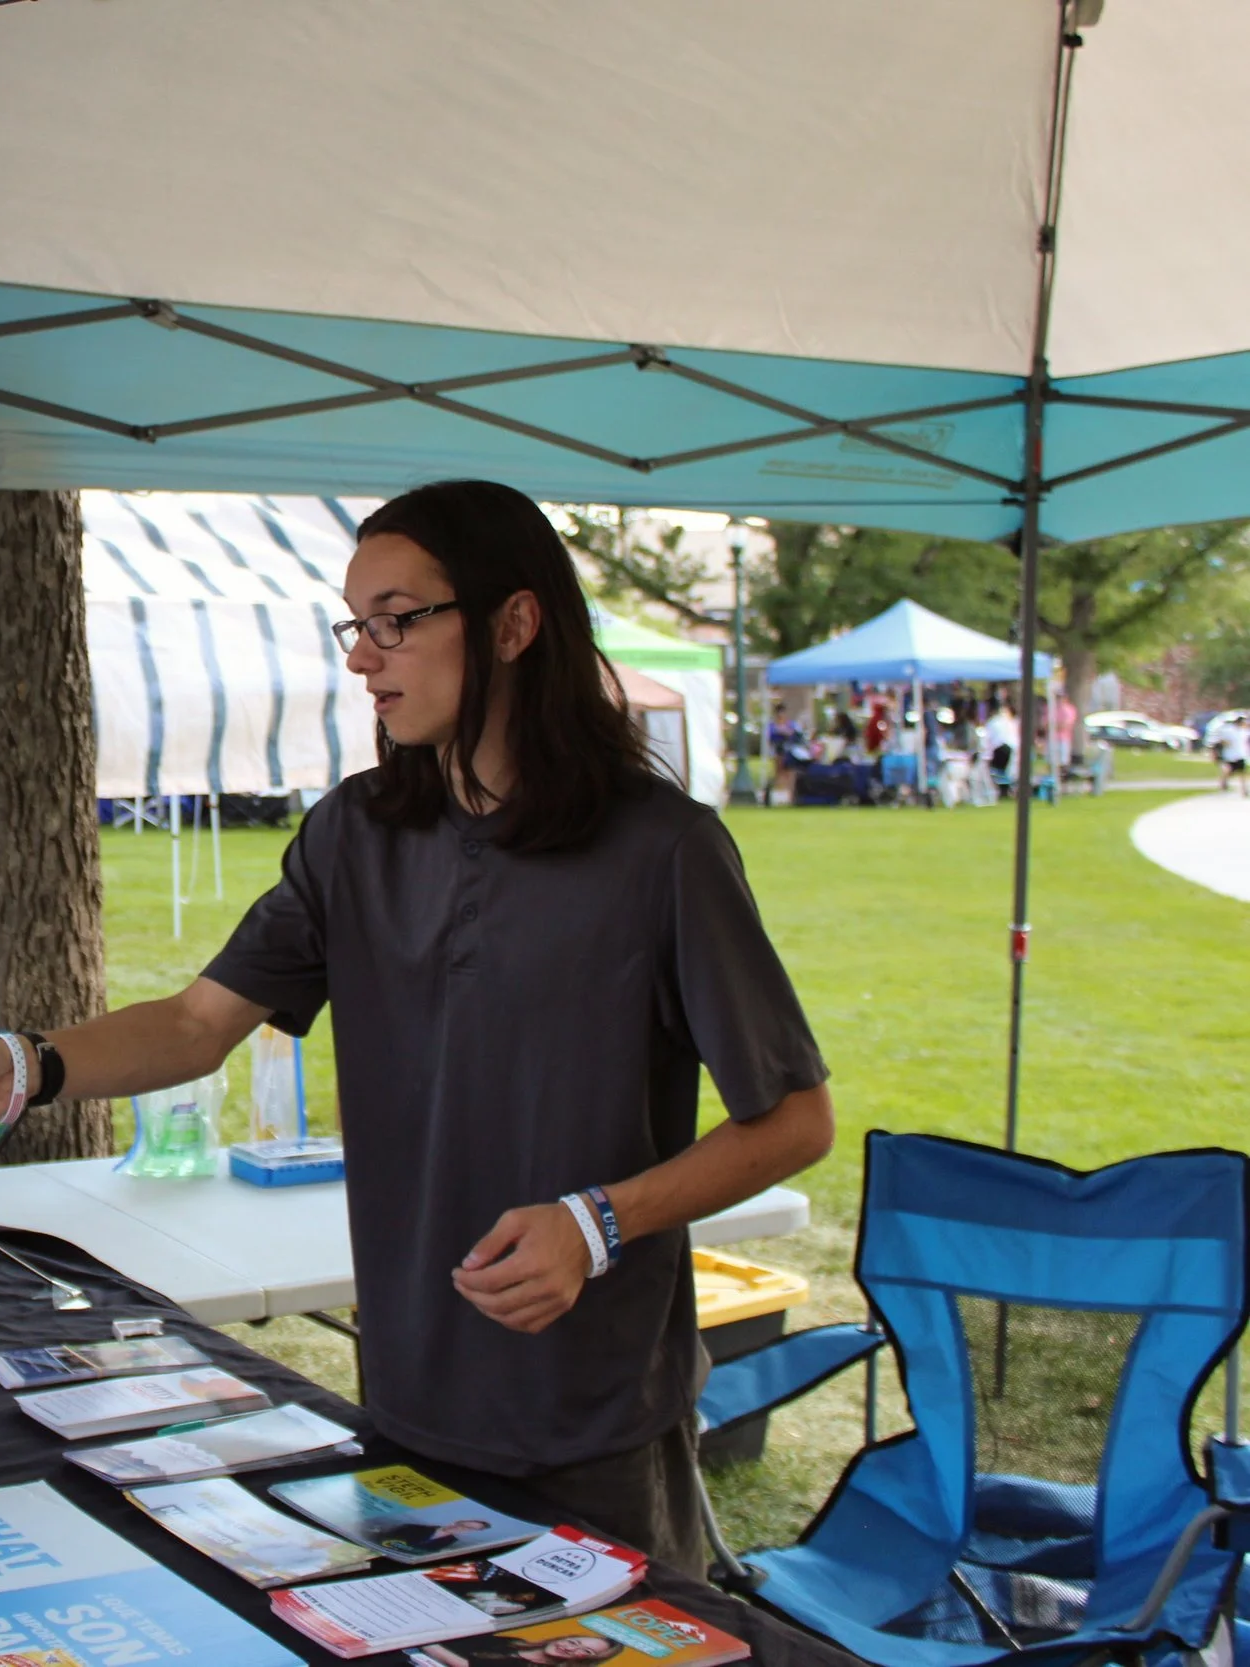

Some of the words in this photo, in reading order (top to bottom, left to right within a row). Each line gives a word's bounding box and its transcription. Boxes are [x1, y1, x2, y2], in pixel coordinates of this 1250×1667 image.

[602, 1211, 620, 1249] USA
[376, 1478, 418, 1501] VIGIL
[385, 1474, 435, 1498] STEPH
[535, 1557, 578, 1579] DUNCAN
[549, 1554, 582, 1572] DETRA
[44, 1604, 161, 1667] SON
[615, 1608, 701, 1649] LOPEZ
